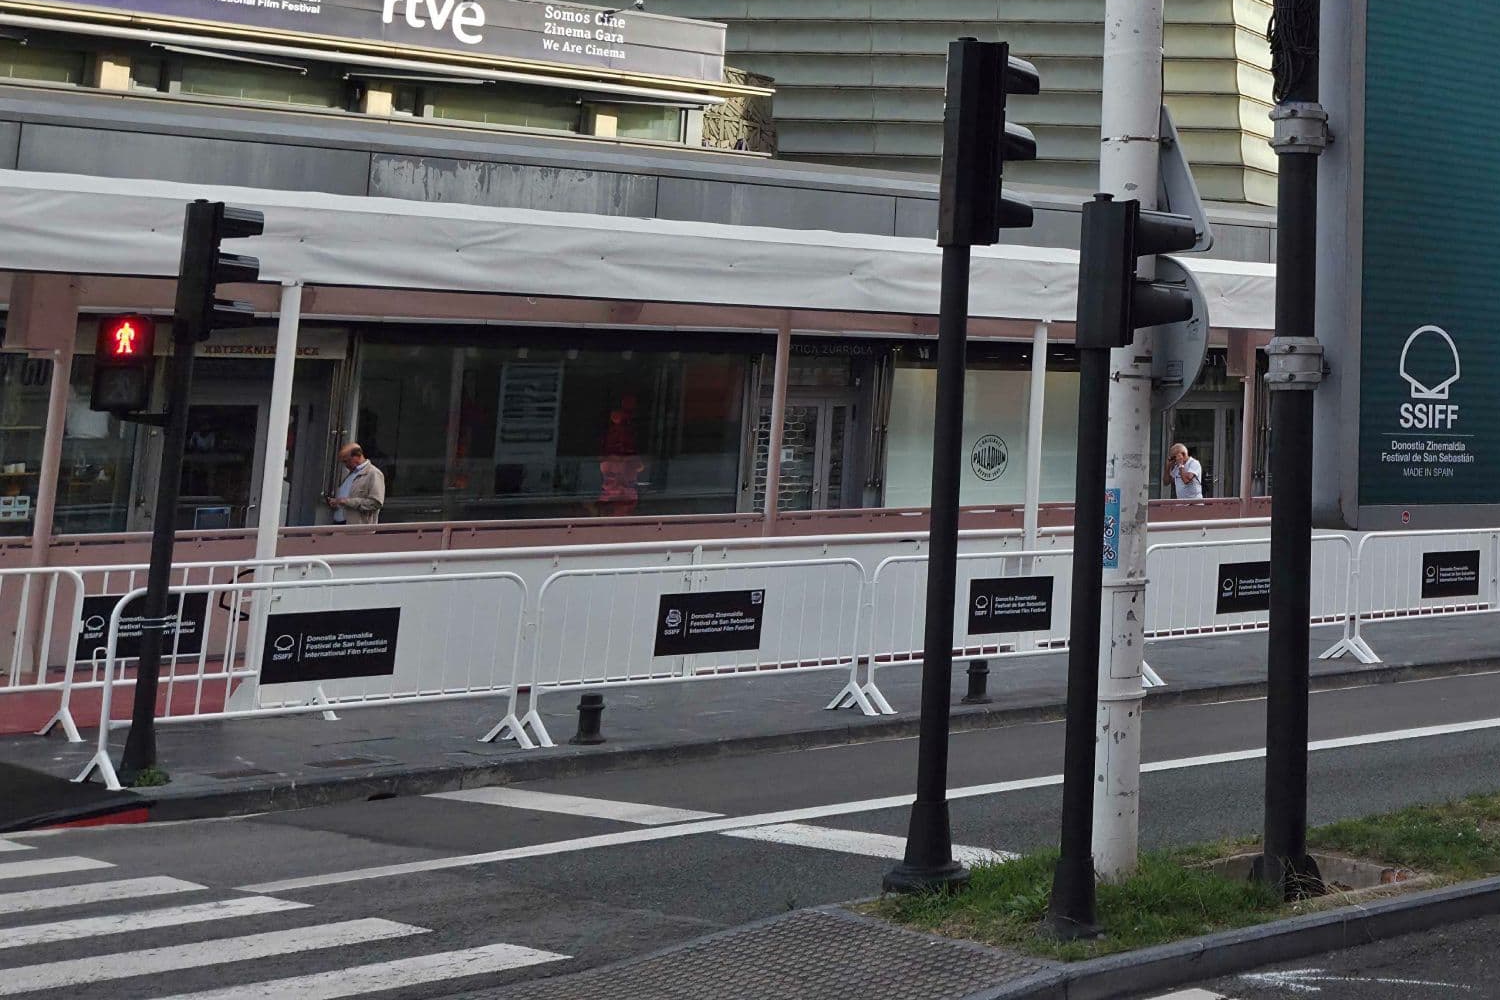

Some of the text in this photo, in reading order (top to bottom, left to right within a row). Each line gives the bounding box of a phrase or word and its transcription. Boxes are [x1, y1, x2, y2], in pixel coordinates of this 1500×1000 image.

[281, 0, 321, 14] Festival
[544, 6, 626, 29] Somos Cine
[543, 22, 624, 44] Zinema Gara
[542, 39, 626, 59] We Are Cinema
[1399, 402, 1459, 429] SSIFF
[1391, 440, 1466, 451] Donostia Zinemaldia
[973, 445, 1006, 471] PALLADIUM
[1381, 452, 1474, 464] Festival de San Sebastián
[1403, 467, 1454, 478] MADE IN SPAIN
[690, 612, 715, 620] Donostia
[688, 626, 723, 635] International
[306, 631, 373, 643] Donostia Zinemaldia
[305, 642, 332, 650] Festival
[342, 640, 355, 648] San
[356, 638, 388, 647] Sebastián
[272, 652, 293, 661] SSIFF
[304, 646, 388, 659] International Film Festival
